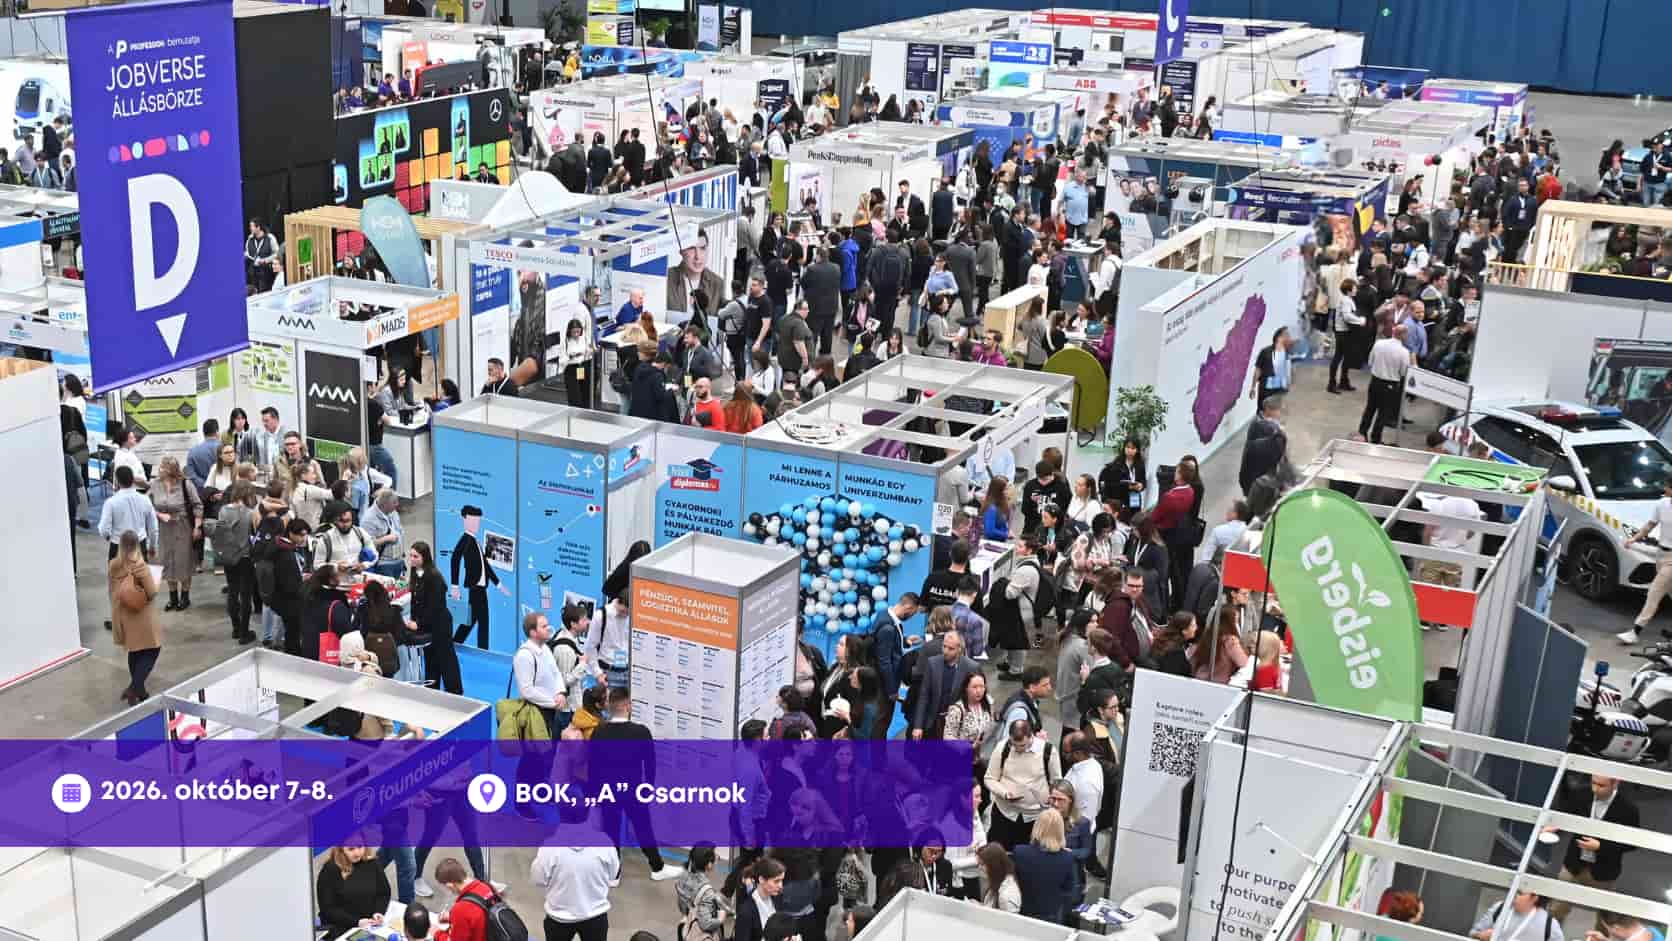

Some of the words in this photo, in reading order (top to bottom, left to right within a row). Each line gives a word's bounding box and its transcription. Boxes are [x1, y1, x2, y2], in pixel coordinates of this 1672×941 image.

[106, 54, 206, 92] JOBVERSE
[1074, 79, 1097, 89] ABB
[112, 87, 204, 119] ÁLLÁSBÖRZE
[127, 172, 201, 311] D
[486, 248, 513, 260] TESCO
[781, 463, 793, 472] MI
[794, 465, 823, 478] LENNE
[824, 471, 832, 479] A
[769, 473, 832, 491] PÁRHUZAMOS
[844, 474, 885, 489] MUNKÁD
[887, 480, 907, 491] EGY
[844, 487, 924, 506] UNIVERZUMBAN?
[664, 499, 722, 517] GYAKORNOKI
[664, 508, 675, 519] ÉS
[380, 745, 455, 807] foundever
[1223, 863, 1250, 880] Our
[1253, 873, 1297, 894] purpo
[1210, 899, 1224, 912] to
[1220, 884, 1285, 910] motivate
[1222, 921, 1236, 934] to
[1239, 926, 1264, 941] the
